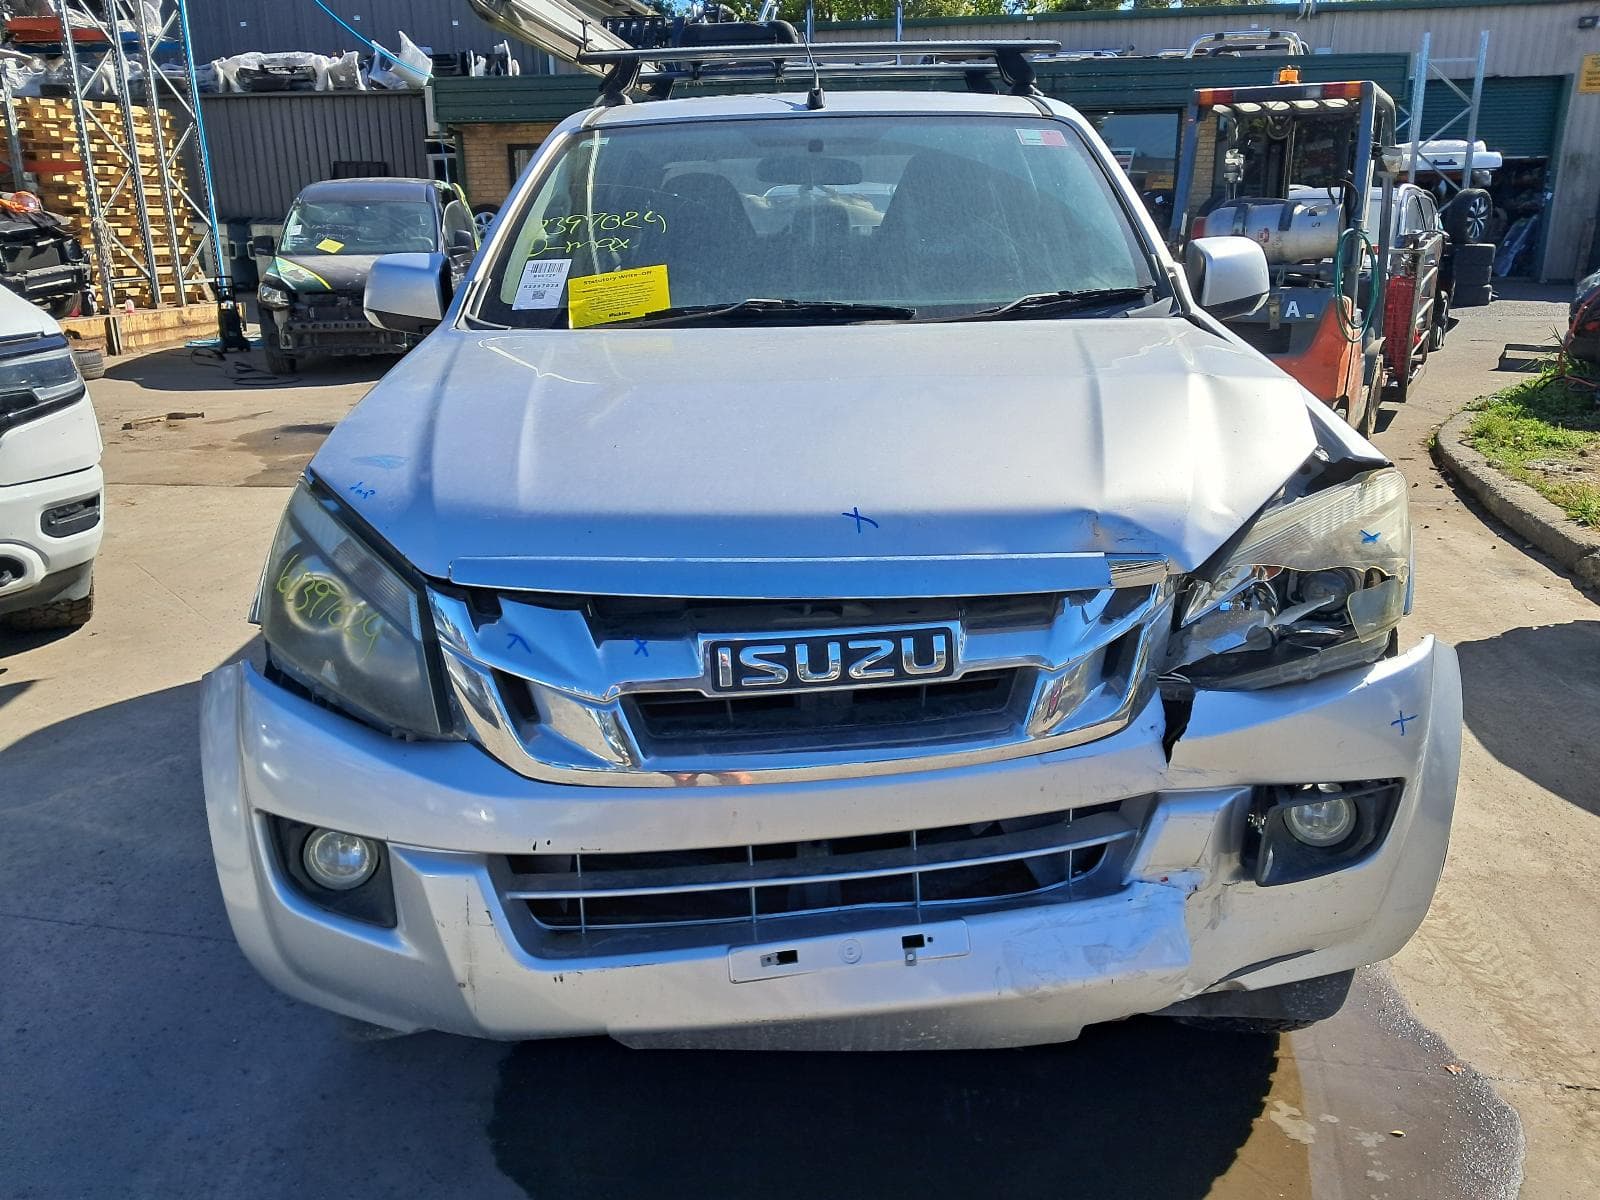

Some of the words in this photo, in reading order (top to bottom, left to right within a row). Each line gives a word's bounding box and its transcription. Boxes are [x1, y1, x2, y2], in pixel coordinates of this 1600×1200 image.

[583, 276, 616, 286] Statutory
[618, 270, 652, 280] Write-Off
[1285, 300, 1301, 318] A
[717, 633, 947, 687] ISUZU
